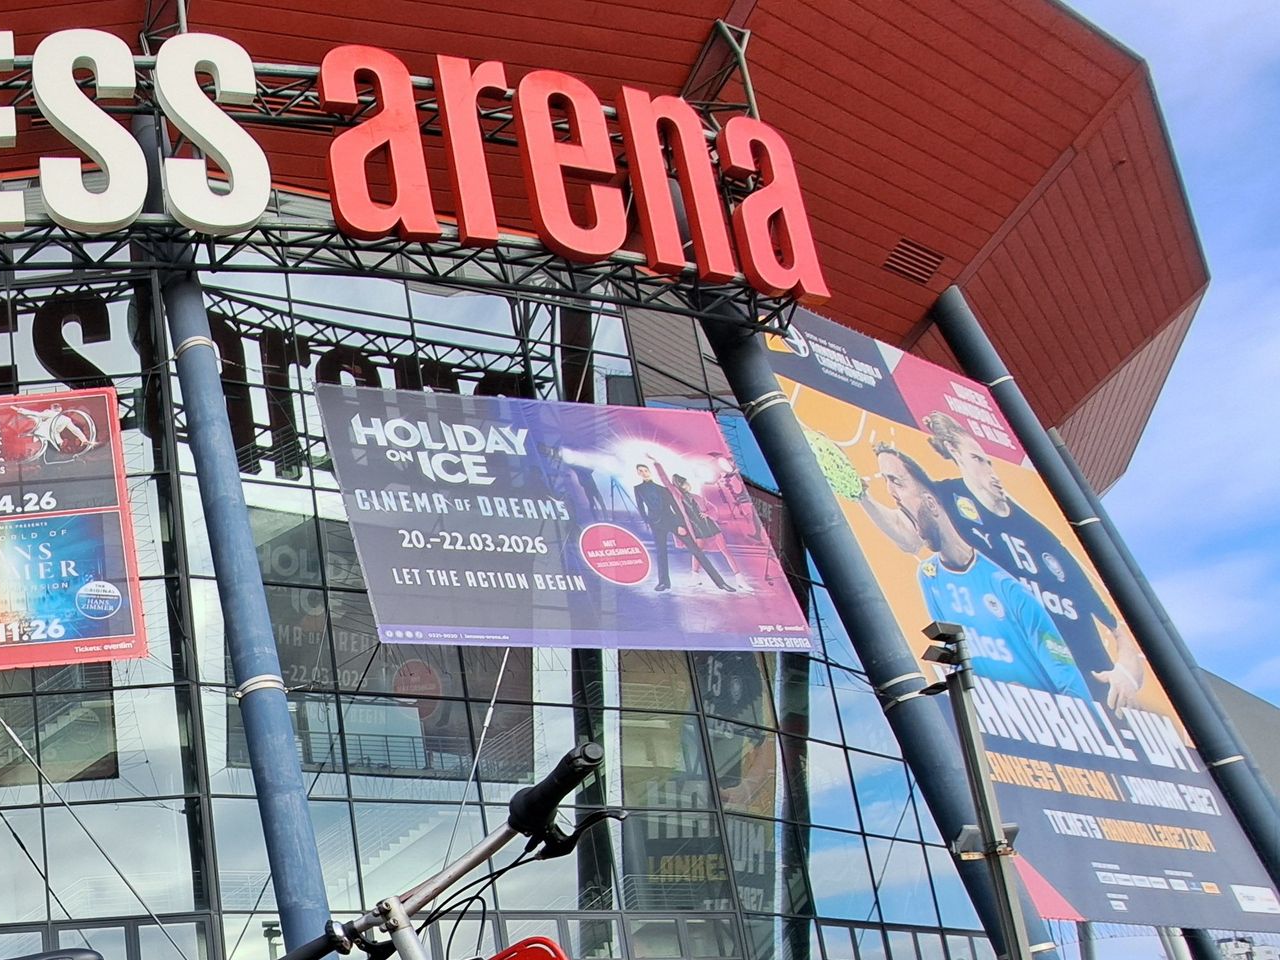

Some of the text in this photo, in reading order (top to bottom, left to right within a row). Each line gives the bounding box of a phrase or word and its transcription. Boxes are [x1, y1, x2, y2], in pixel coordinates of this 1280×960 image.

[319, 45, 831, 300] arena
[350, 412, 529, 456] HOLIDAY
[385, 448, 497, 485] ON ICE
[354, 489, 571, 521] CINEMA OF DREAMS
[49, 529, 67, 537] OF
[1000, 532, 1038, 575] 15
[392, 567, 587, 592] LET THE ACTION BEGIN
[749, 636, 811, 648] LANXESS arena
[1054, 764, 1120, 801] ARENA
[1043, 809, 1104, 840] TICKETS
